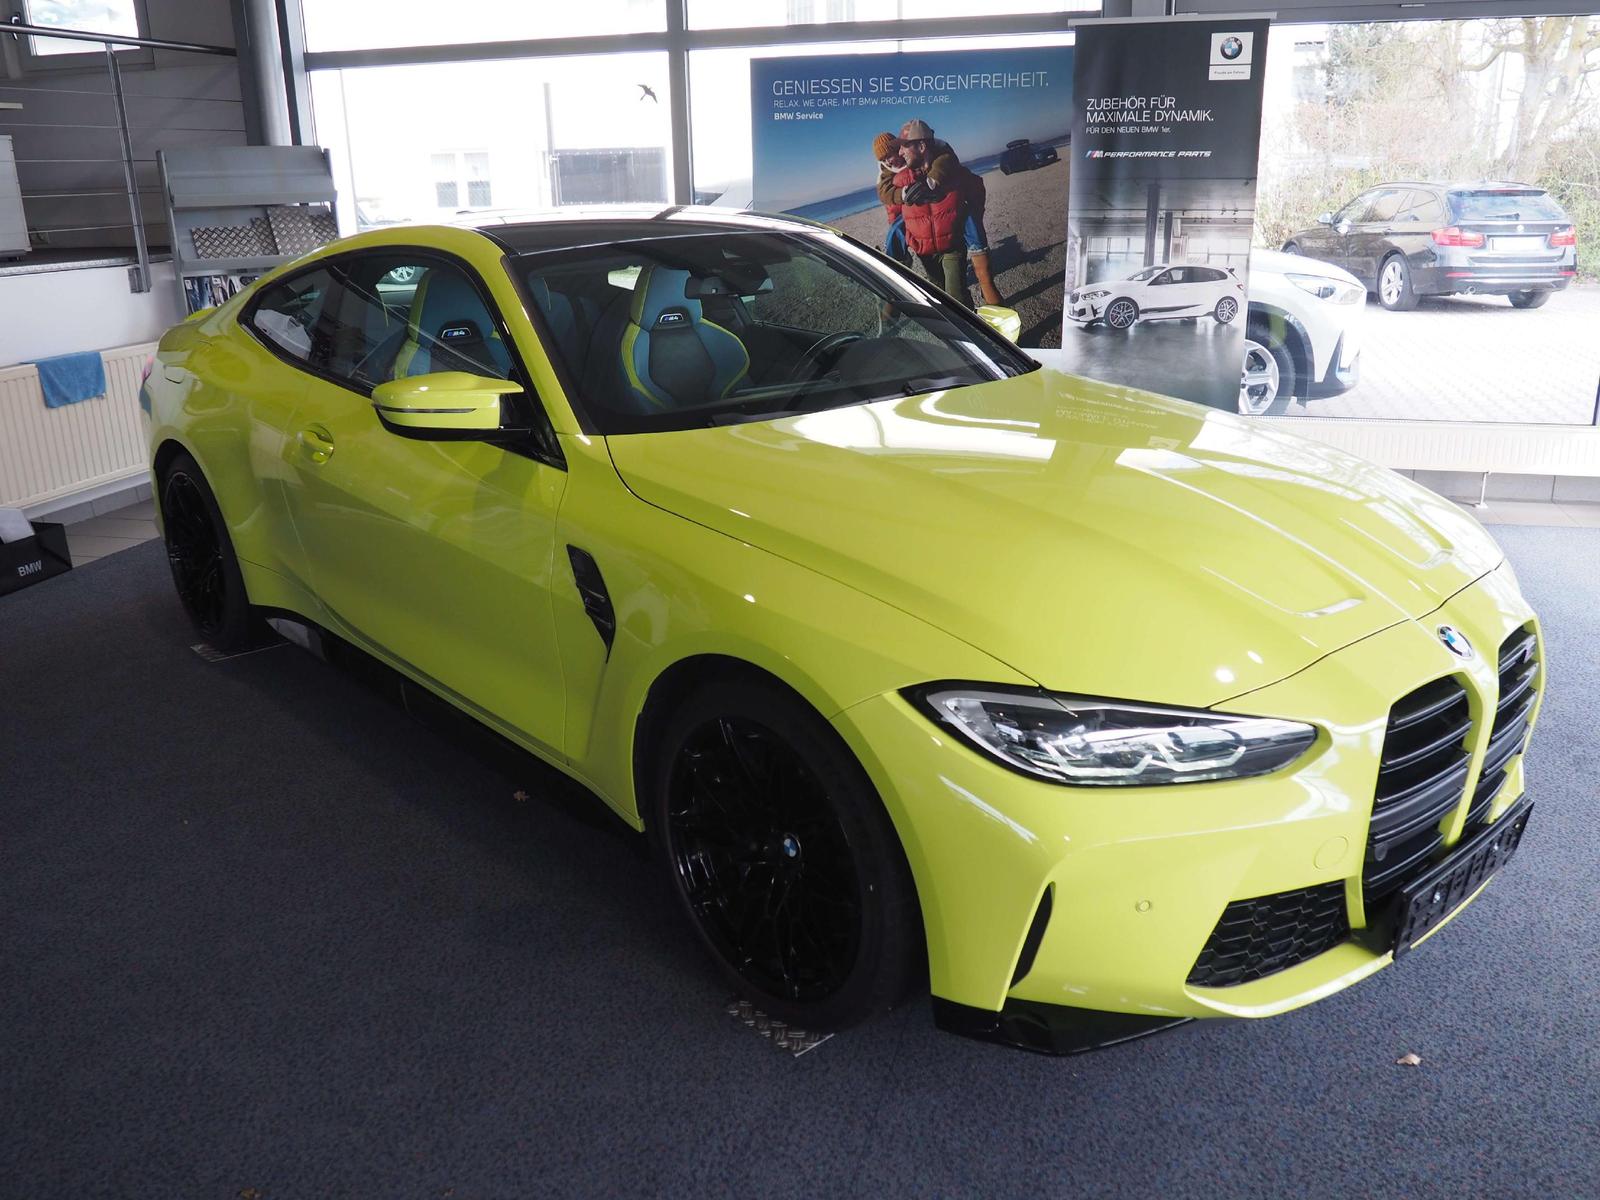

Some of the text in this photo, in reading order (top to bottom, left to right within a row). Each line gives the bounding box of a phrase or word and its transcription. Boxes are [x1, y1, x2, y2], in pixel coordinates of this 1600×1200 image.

[772, 71, 1049, 96] GENIESSEN SIE SORGENFREIHEIT.
[773, 94, 952, 108] RELAX. WE CARE. MIT BMW PROACTIVE CARE.
[1086, 94, 1176, 110] ZUBEHÖR FÜR
[774, 111, 824, 120] BMW Service
[1086, 109, 1214, 123] MAXIMALE DYNAMIK.
[1086, 125, 1100, 134] FÜR
[1101, 126, 1115, 134] DEN
[1177, 150, 1212, 158] PARTS
[17, 559, 42, 577] BMW
